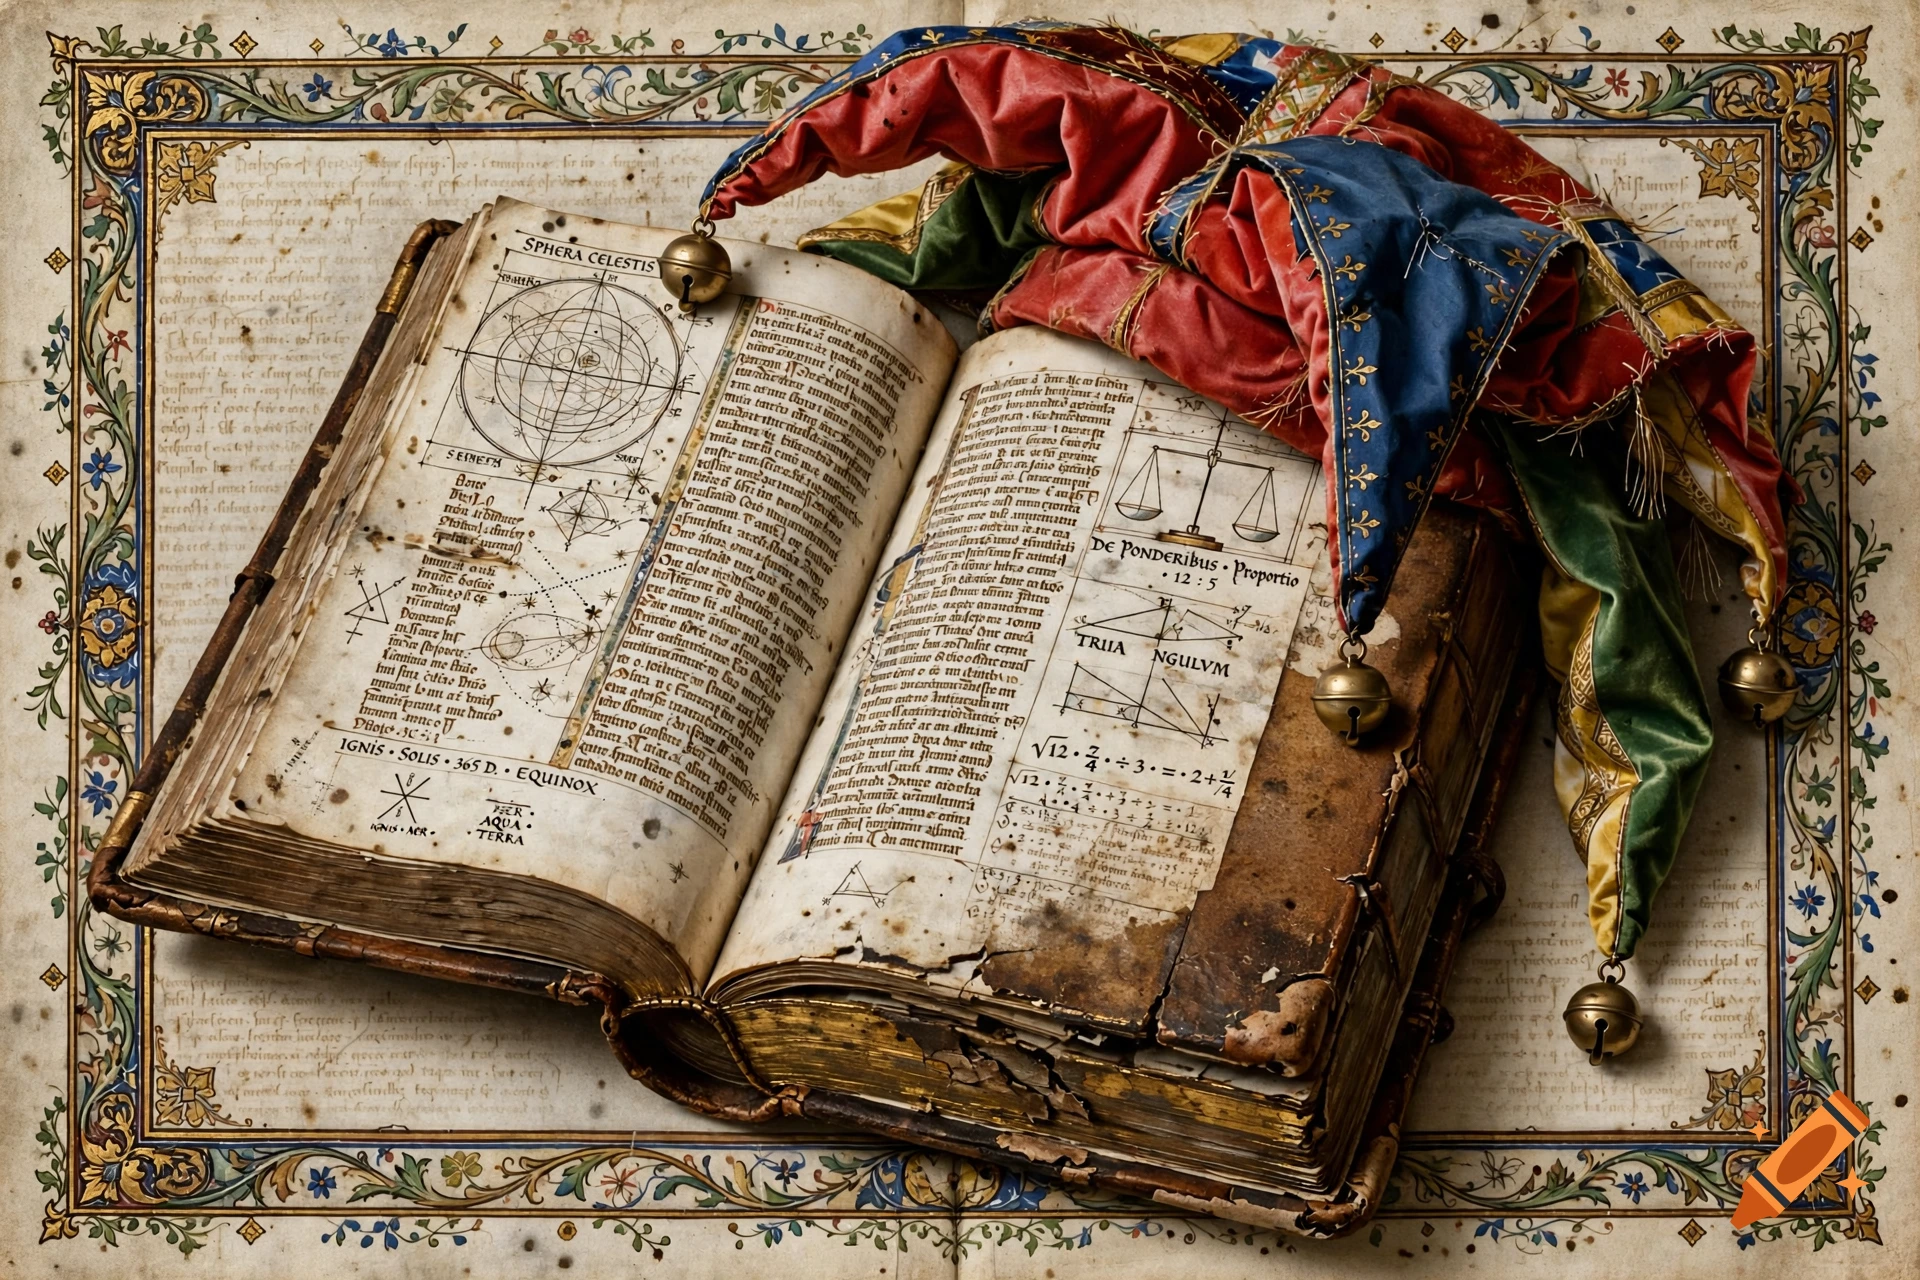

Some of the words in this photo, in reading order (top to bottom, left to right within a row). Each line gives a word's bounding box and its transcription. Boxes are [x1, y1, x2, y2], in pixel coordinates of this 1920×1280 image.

[588, 251, 656, 273] CELESTIS
[1173, 572, 1191, 585] 12
[397, 747, 441, 766] SOLIS
[453, 757, 481, 773] 365
[516, 766, 600, 796] EQUINOX
[479, 815, 521, 832] AQUA
[476, 828, 525, 846] TERRA
